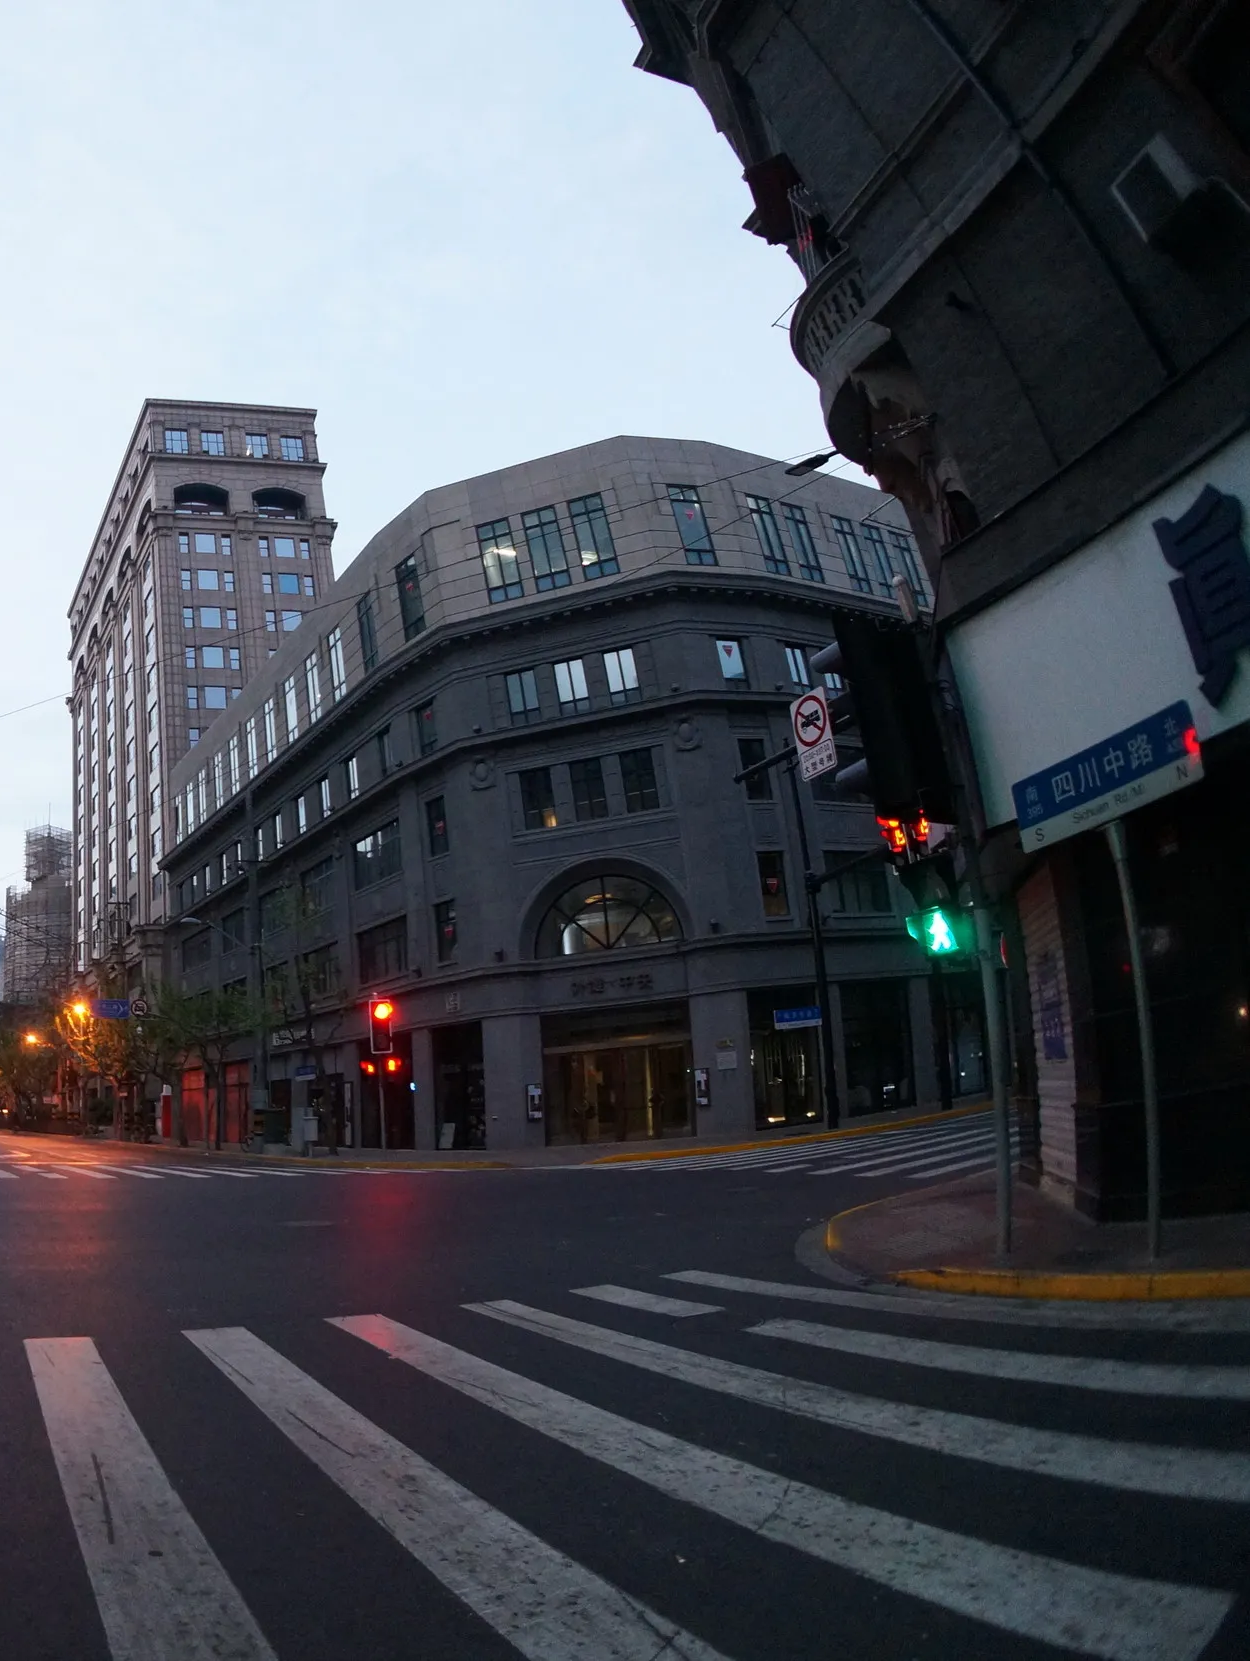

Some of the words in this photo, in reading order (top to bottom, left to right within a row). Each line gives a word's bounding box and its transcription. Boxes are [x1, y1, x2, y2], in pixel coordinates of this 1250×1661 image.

[1051, 733, 1154, 804] 四川中路
[1176, 764, 1189, 781] N
[1025, 785, 1039, 805] 南
[1035, 827, 1045, 843] S
